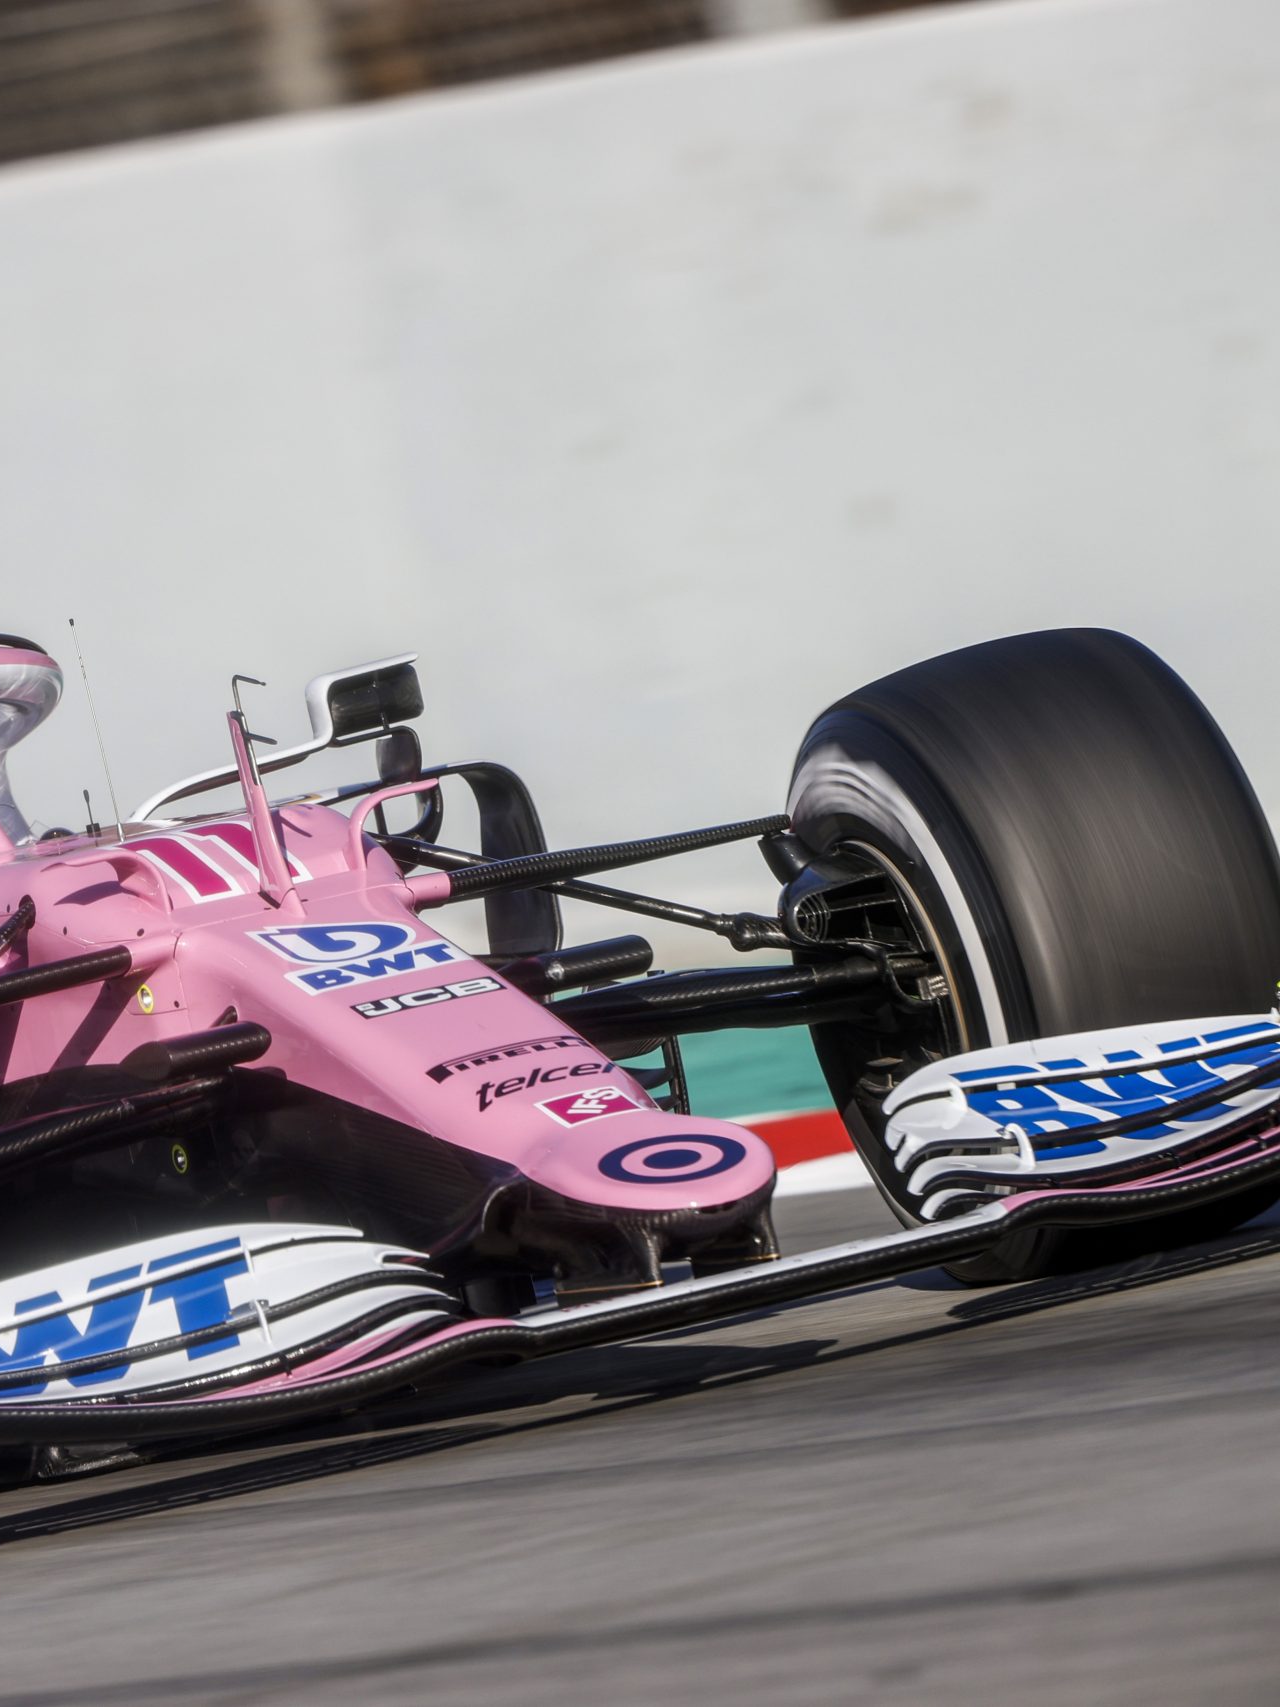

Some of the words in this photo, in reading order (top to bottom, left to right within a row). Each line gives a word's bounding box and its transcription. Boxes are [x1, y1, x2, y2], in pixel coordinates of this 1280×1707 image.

[297, 943, 455, 991] BWT
[355, 976, 502, 1017] JCB
[567, 1086, 621, 1114] IFS
